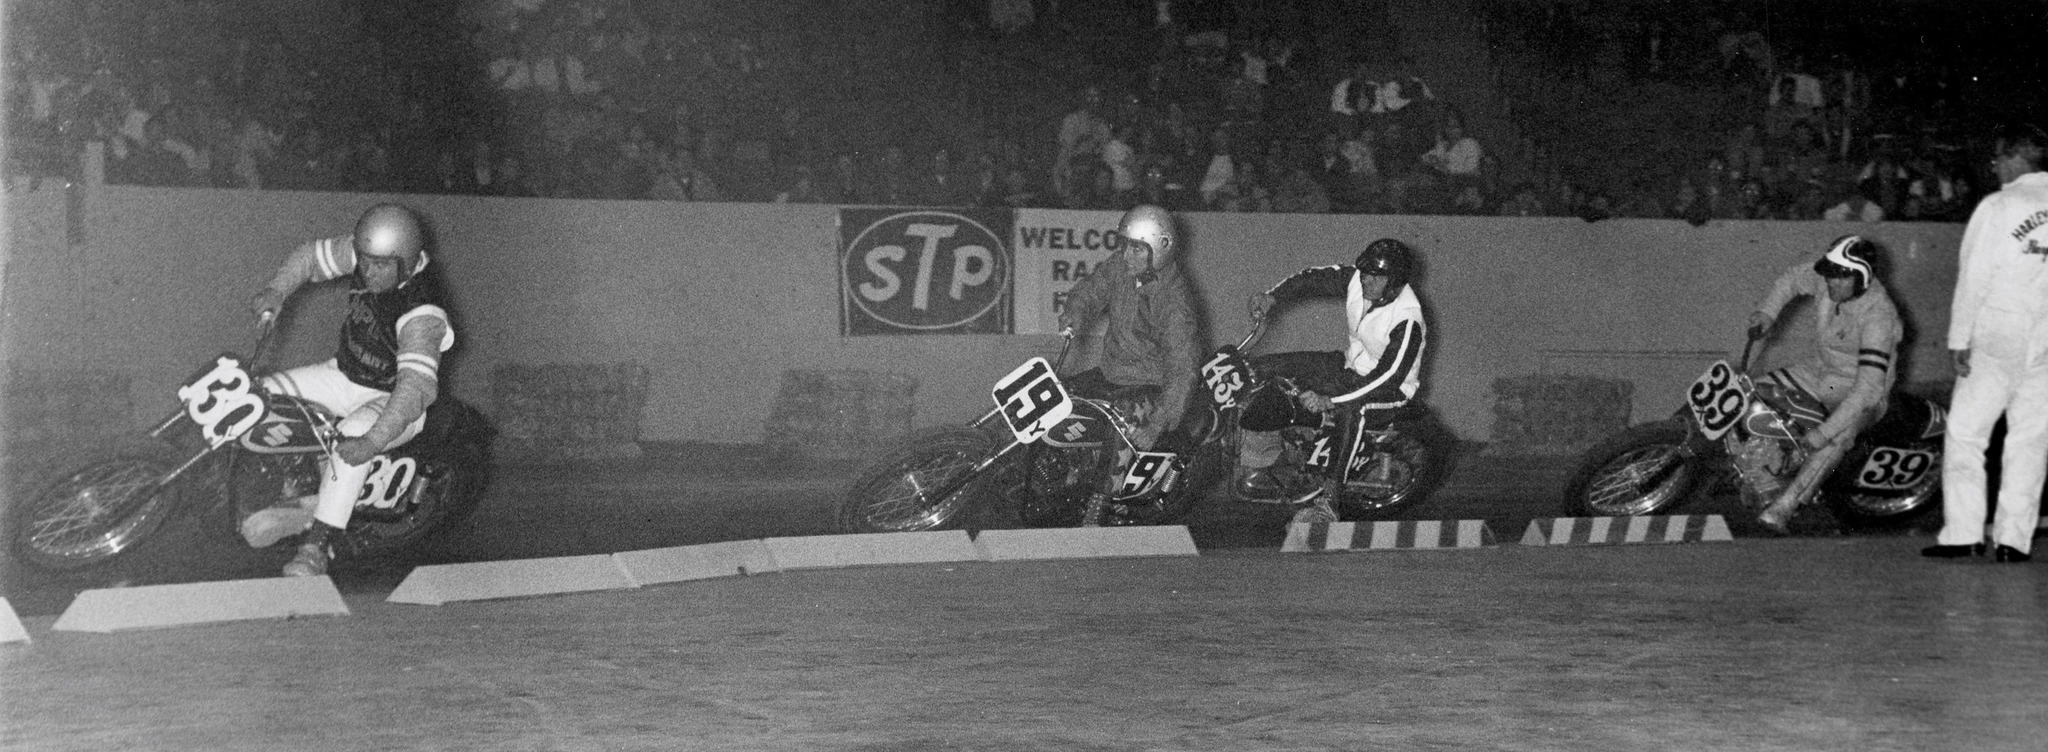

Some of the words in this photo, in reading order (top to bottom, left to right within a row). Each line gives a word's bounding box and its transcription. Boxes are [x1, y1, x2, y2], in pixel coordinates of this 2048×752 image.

[1021, 226, 1120, 251] WELCO
[859, 223, 993, 311] STP
[1052, 260, 1099, 281] RA
[1690, 363, 1745, 431] 39
[356, 455, 416, 509] 30
[1121, 455, 1166, 496] 9
[1863, 449, 1930, 485] 39
